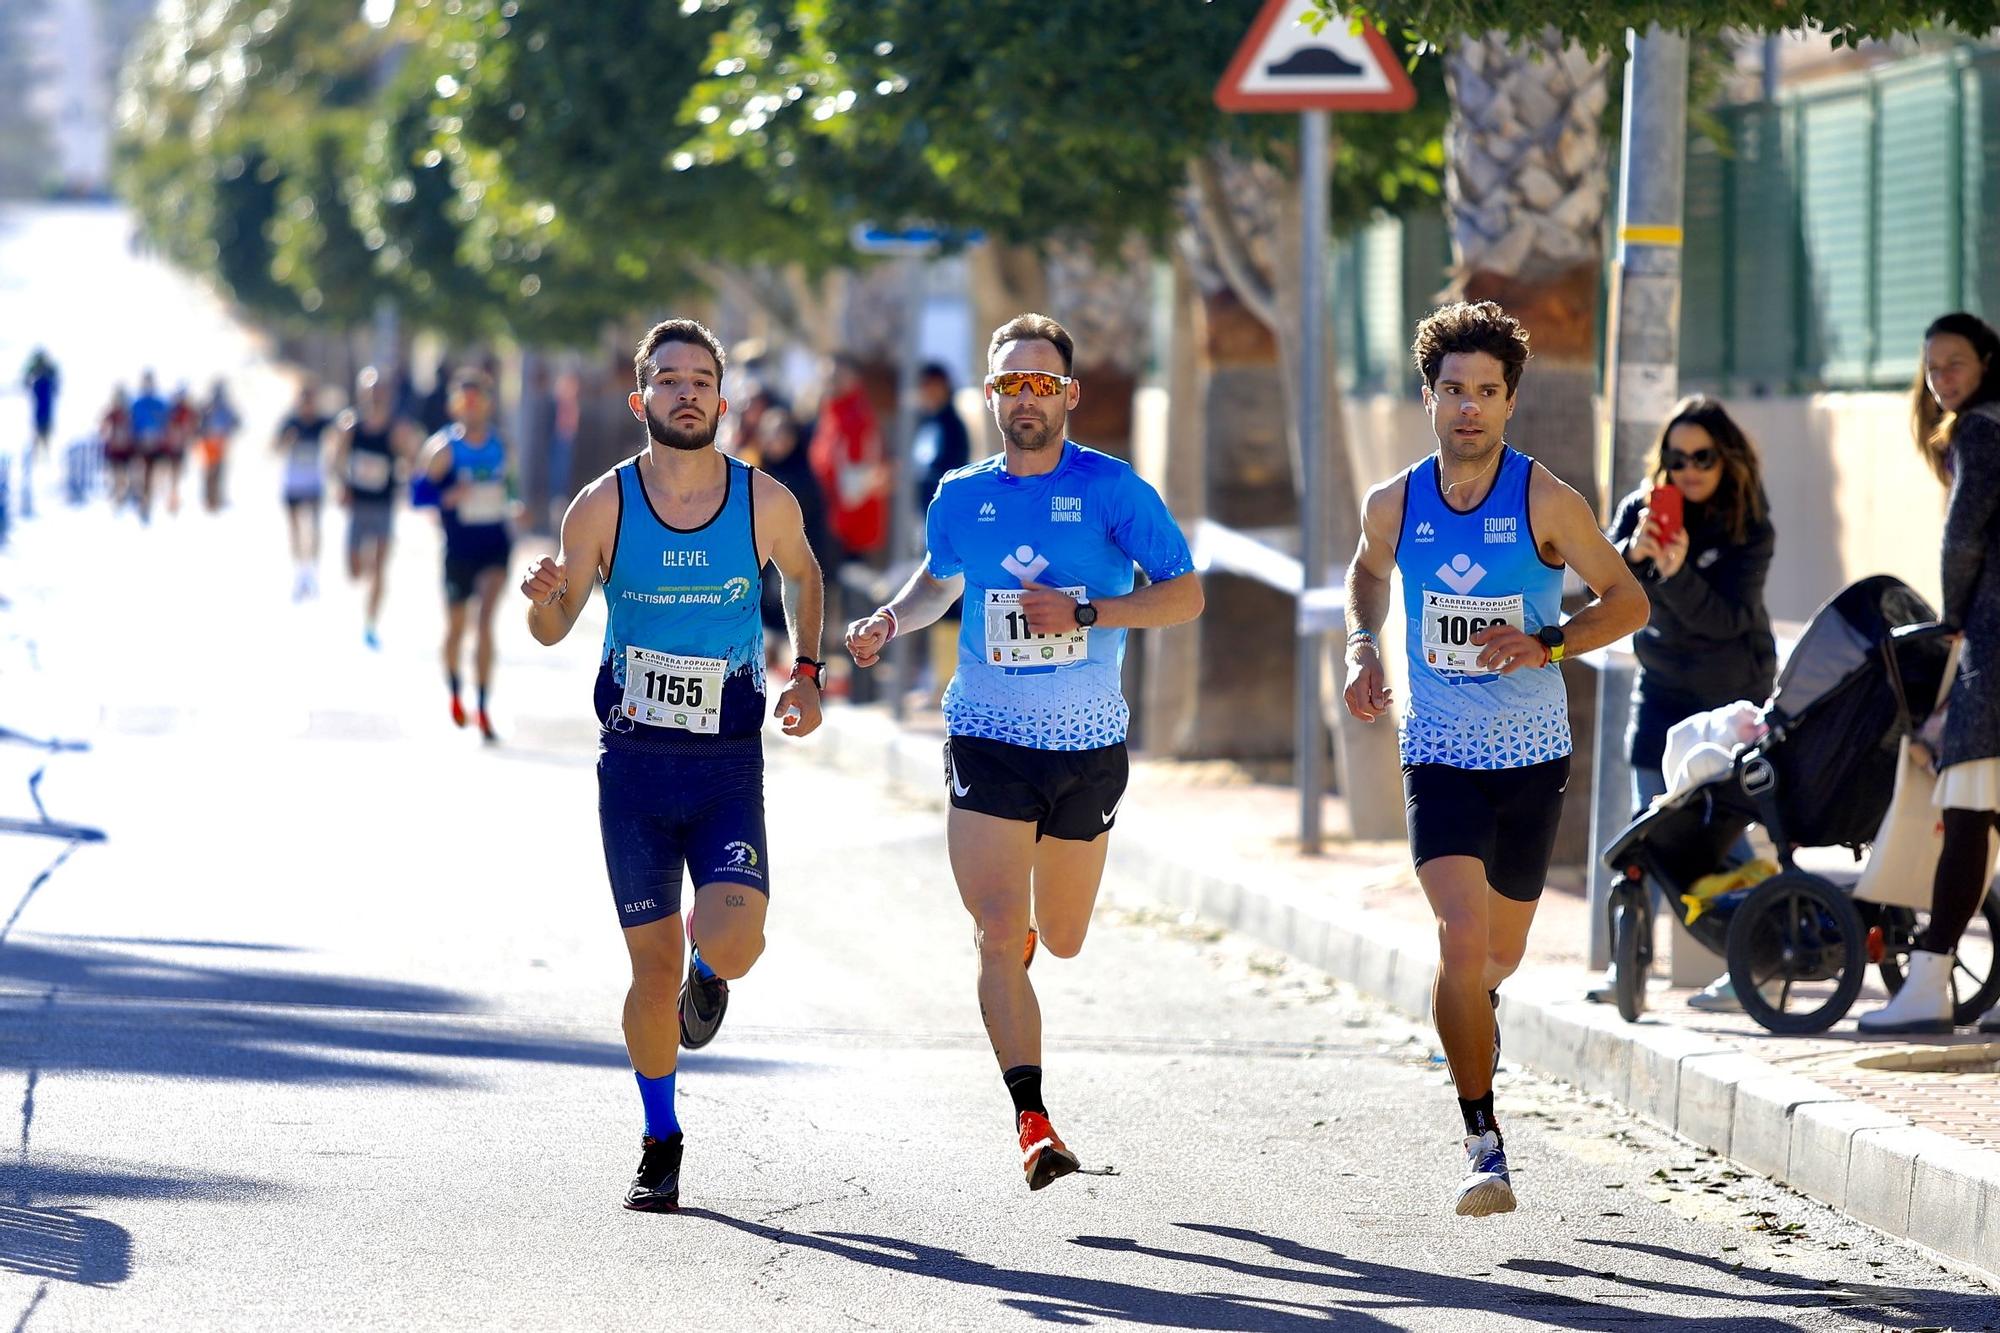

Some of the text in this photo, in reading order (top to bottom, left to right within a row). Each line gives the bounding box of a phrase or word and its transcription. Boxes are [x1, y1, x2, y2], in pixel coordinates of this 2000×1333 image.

[1051, 496, 1082, 511] EQUIPO
[1051, 511, 1082, 522] RUNNERS
[1484, 517, 1517, 532] EQUIPO
[1484, 532, 1517, 543] RUNNERS
[621, 589, 722, 604] ATLETISMO ABARÁN
[991, 593, 1000, 603] X
[1430, 596, 1518, 607] X CARRERA POPULAR
[1005, 611, 1063, 640] 11
[634, 650, 721, 668] X CARRERA POPULAR
[644, 670, 703, 708] 1155
